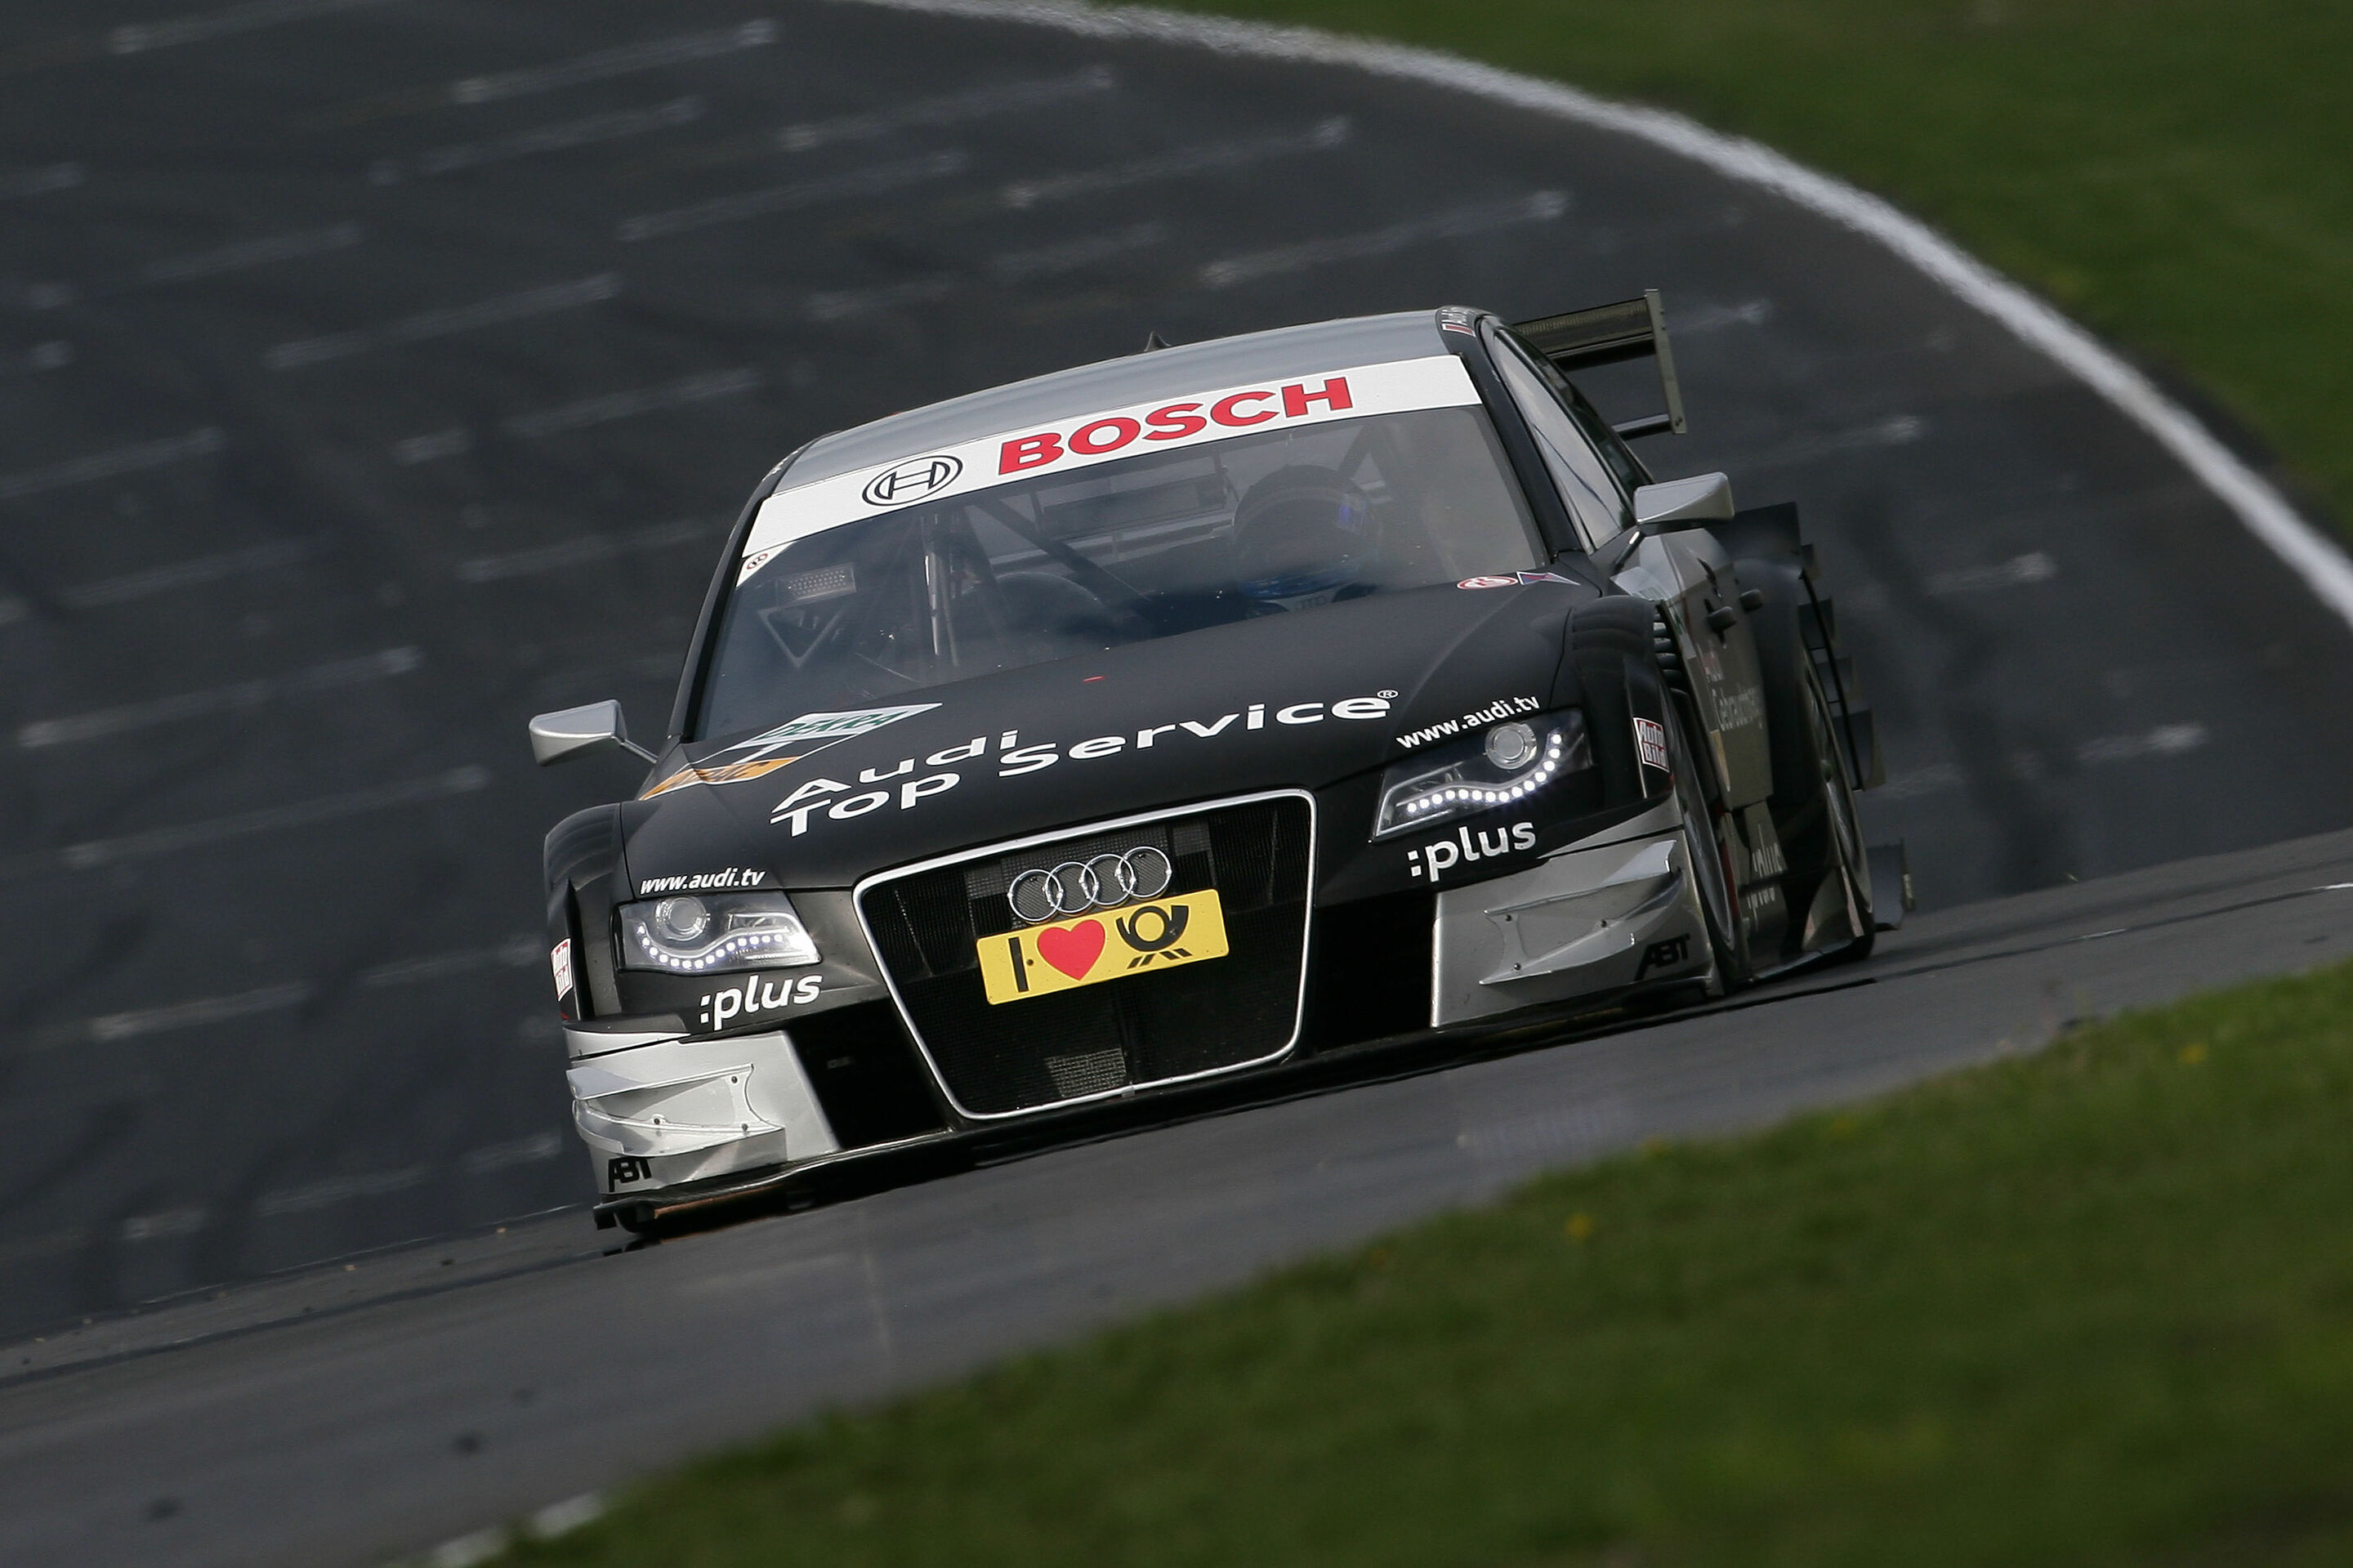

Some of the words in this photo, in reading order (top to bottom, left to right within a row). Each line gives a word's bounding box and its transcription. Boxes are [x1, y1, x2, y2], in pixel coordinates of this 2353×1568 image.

[998, 377, 1353, 475] BOSCH
[1396, 693, 1540, 749] www.audi.tv
[771, 730, 1019, 813] Audi
[770, 772, 961, 837] Top
[640, 868, 766, 895] www.audi.tv
[1008, 936, 1029, 993] I
[1637, 934, 1690, 978] ABT
[609, 1156, 654, 1192] ABT
